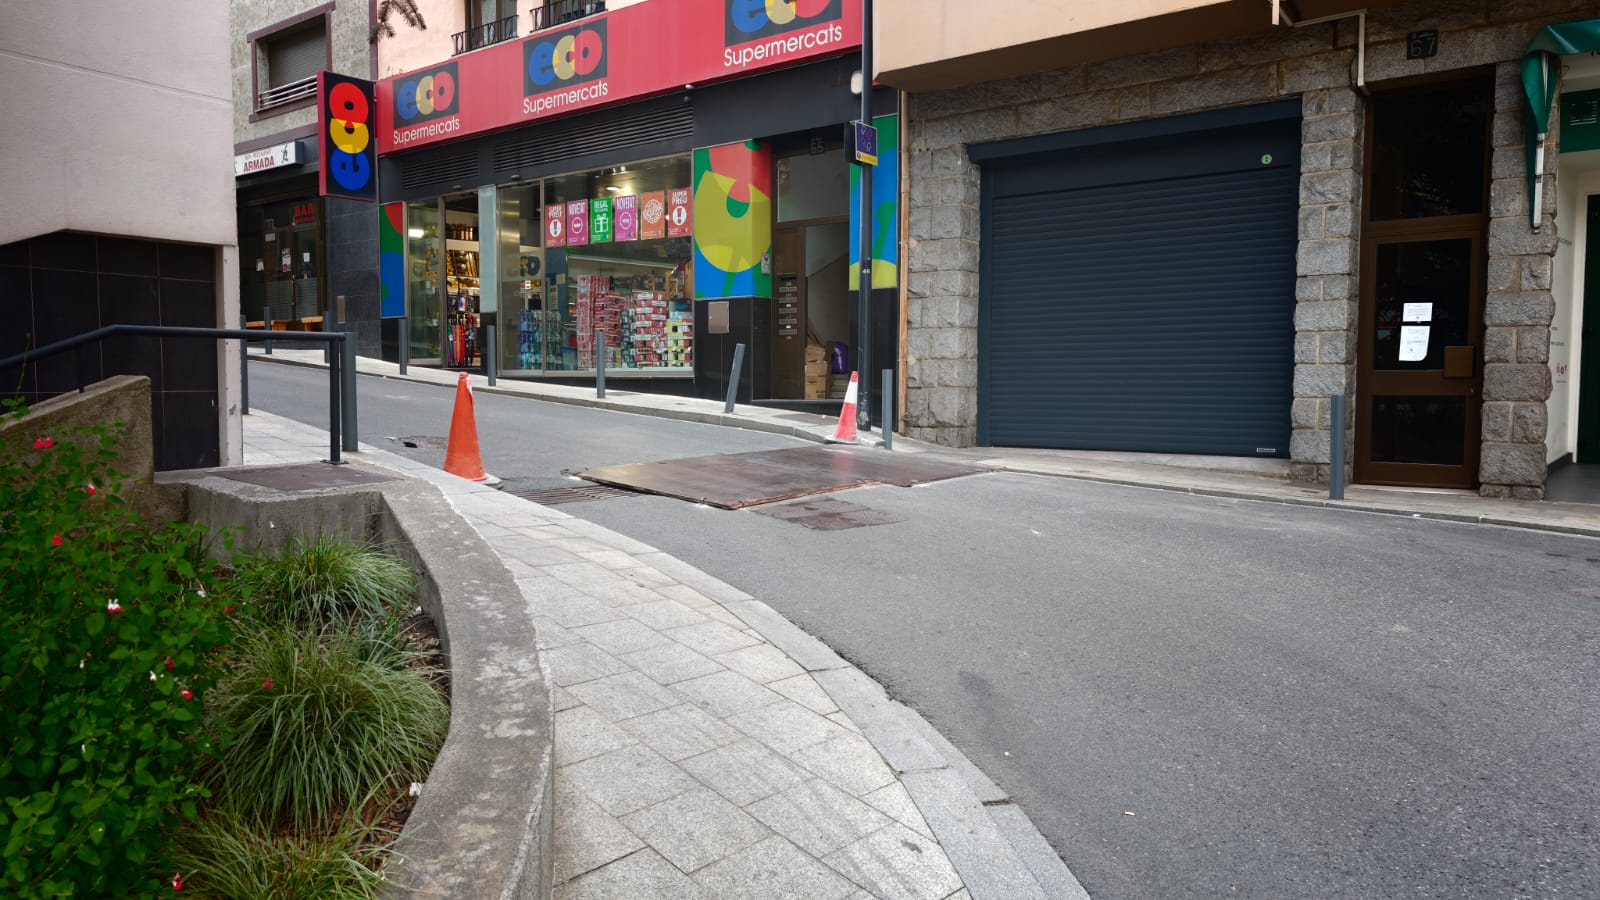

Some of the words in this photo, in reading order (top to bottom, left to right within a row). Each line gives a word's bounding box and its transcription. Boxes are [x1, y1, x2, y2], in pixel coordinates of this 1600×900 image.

[529, 29, 603, 86] eco
[724, 23, 842, 67] Supermercats
[1410, 36, 1436, 57] 67
[397, 71, 455, 121] eco
[523, 80, 608, 114] Supermercats
[329, 82, 370, 191] eco
[393, 116, 460, 145] Supermercats
[243, 156, 275, 173] ARMADA
